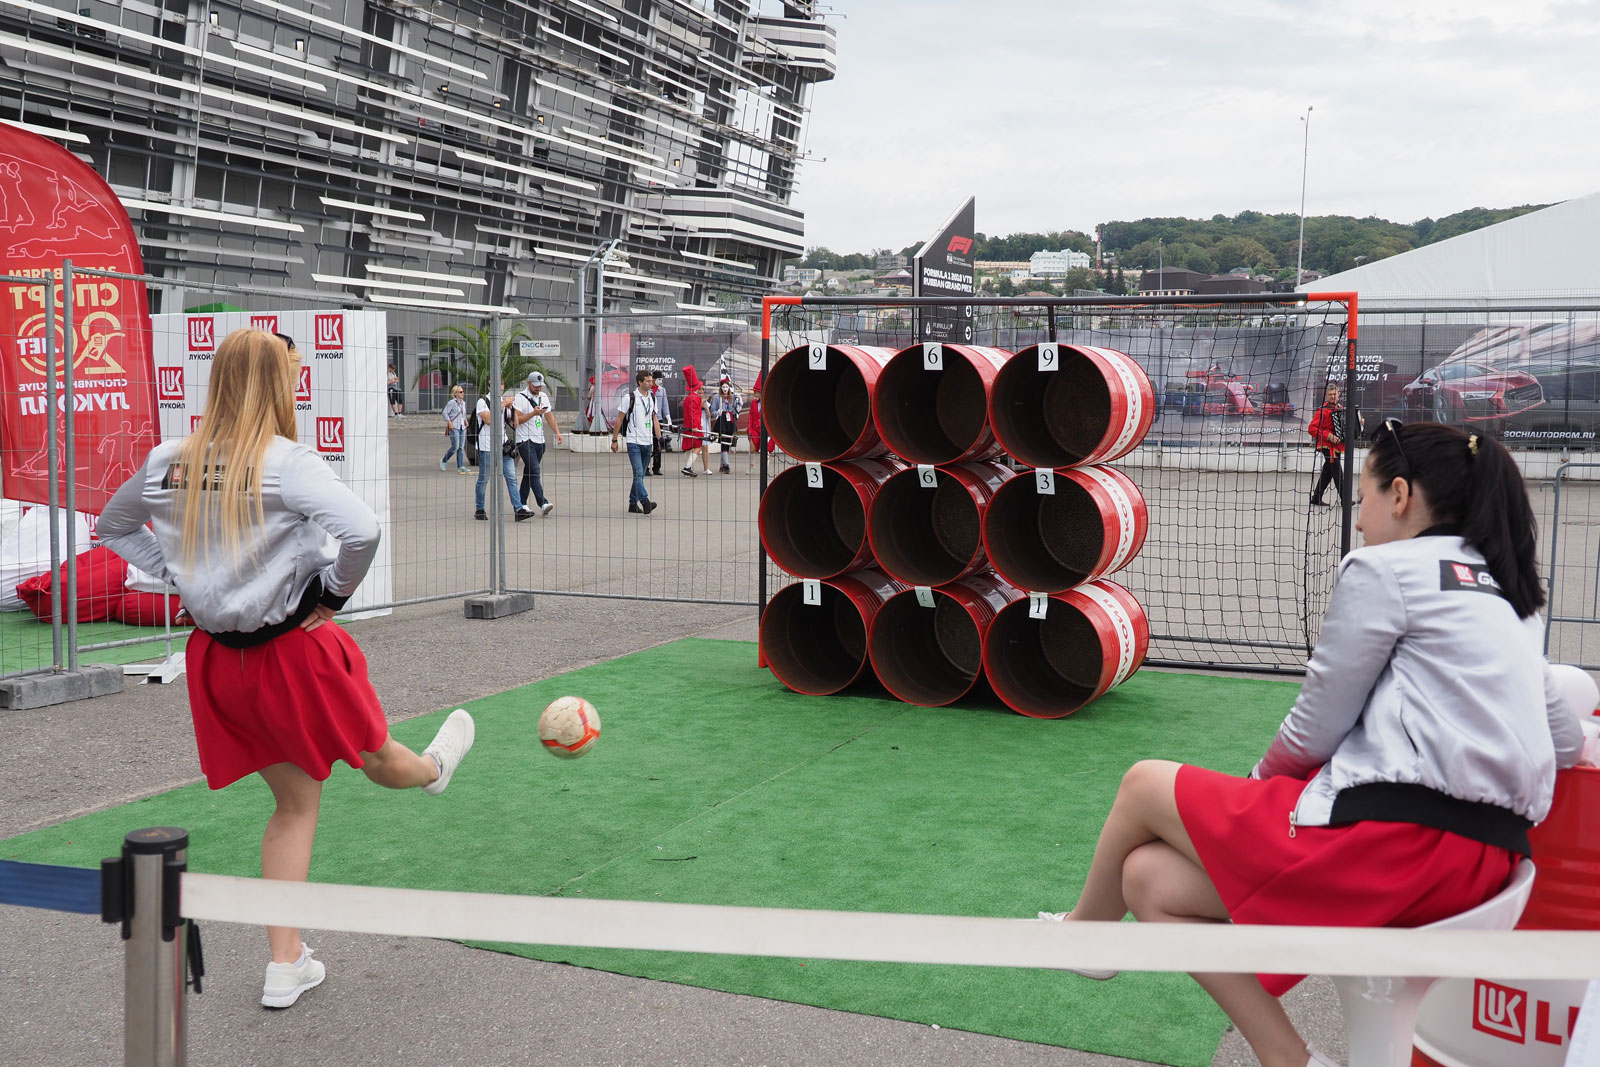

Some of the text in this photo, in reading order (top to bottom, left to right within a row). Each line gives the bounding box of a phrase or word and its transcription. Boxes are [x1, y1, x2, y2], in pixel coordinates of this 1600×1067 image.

[923, 267, 947, 280] FORMULA
[963, 274, 973, 284] VTB
[923, 276, 973, 293] RUSSIAN GRAND PRIX
[188, 353, 215, 361] ЛУКОЙЛ
[315, 352, 344, 360] ЛУКОЙЛ
[812, 346, 823, 364] 9
[927, 346, 938, 364] 6
[1042, 348, 1054, 367] 9
[1325, 373, 1380, 381] ФОРУЛЫ
[159, 402, 186, 410] ЛУКОЙЛ
[1503, 430, 1595, 439] SOCHIAUTODROM.RU
[809, 467, 819, 484] 3
[922, 469, 933, 484] 6
[1039, 473, 1050, 490] 3
[809, 584, 816, 601] 1
[1034, 597, 1041, 614] 1
